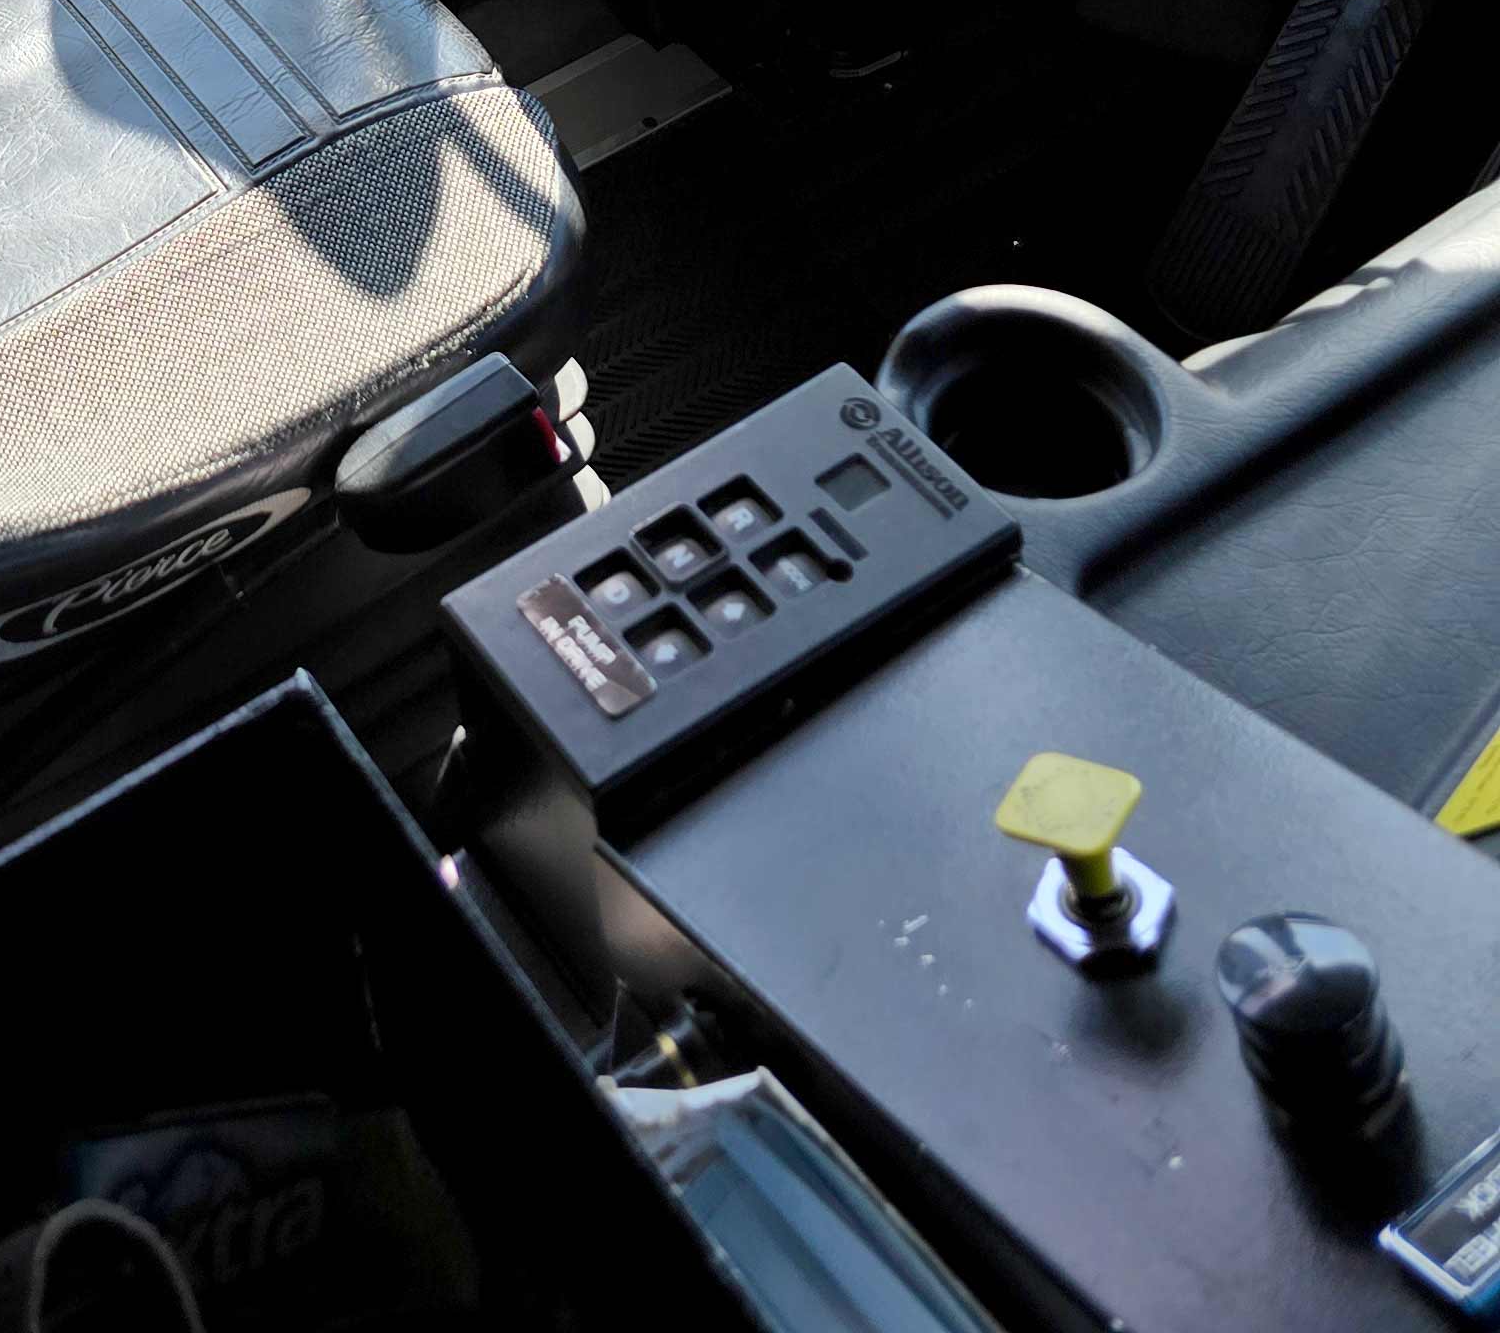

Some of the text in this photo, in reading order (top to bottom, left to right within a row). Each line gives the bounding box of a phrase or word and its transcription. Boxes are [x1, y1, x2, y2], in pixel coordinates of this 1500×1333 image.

[874, 425, 972, 513] Allison
[726, 507, 754, 532] R
[666, 546, 696, 570] N
[605, 586, 626, 606] D
[539, 615, 609, 692] IN DRIVE
[567, 612, 618, 666] PUMP
[162, 1173, 326, 1291] xtra
